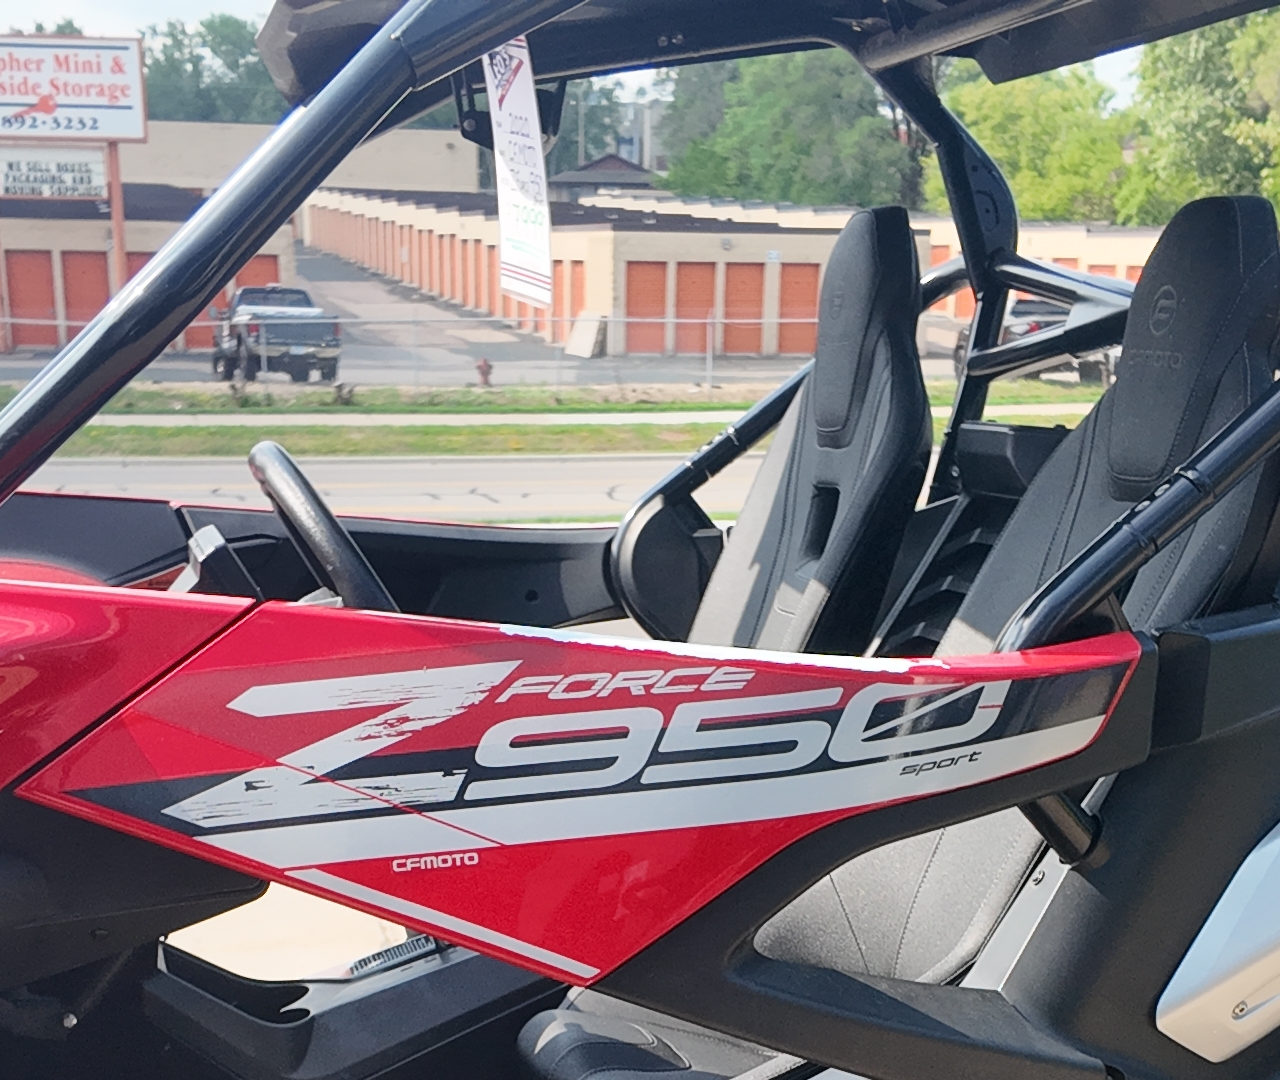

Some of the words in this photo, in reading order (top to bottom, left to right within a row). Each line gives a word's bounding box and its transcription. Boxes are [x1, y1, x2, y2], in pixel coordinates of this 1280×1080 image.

[53, 53, 102, 74] Mini
[110, 55, 127, 74] &
[49, 77, 132, 104] Storage
[496, 666, 757, 703] FORCE
[464, 680, 1012, 801] 950
[899, 752, 982, 776] sport
[392, 852, 479, 872] CFMOTO
